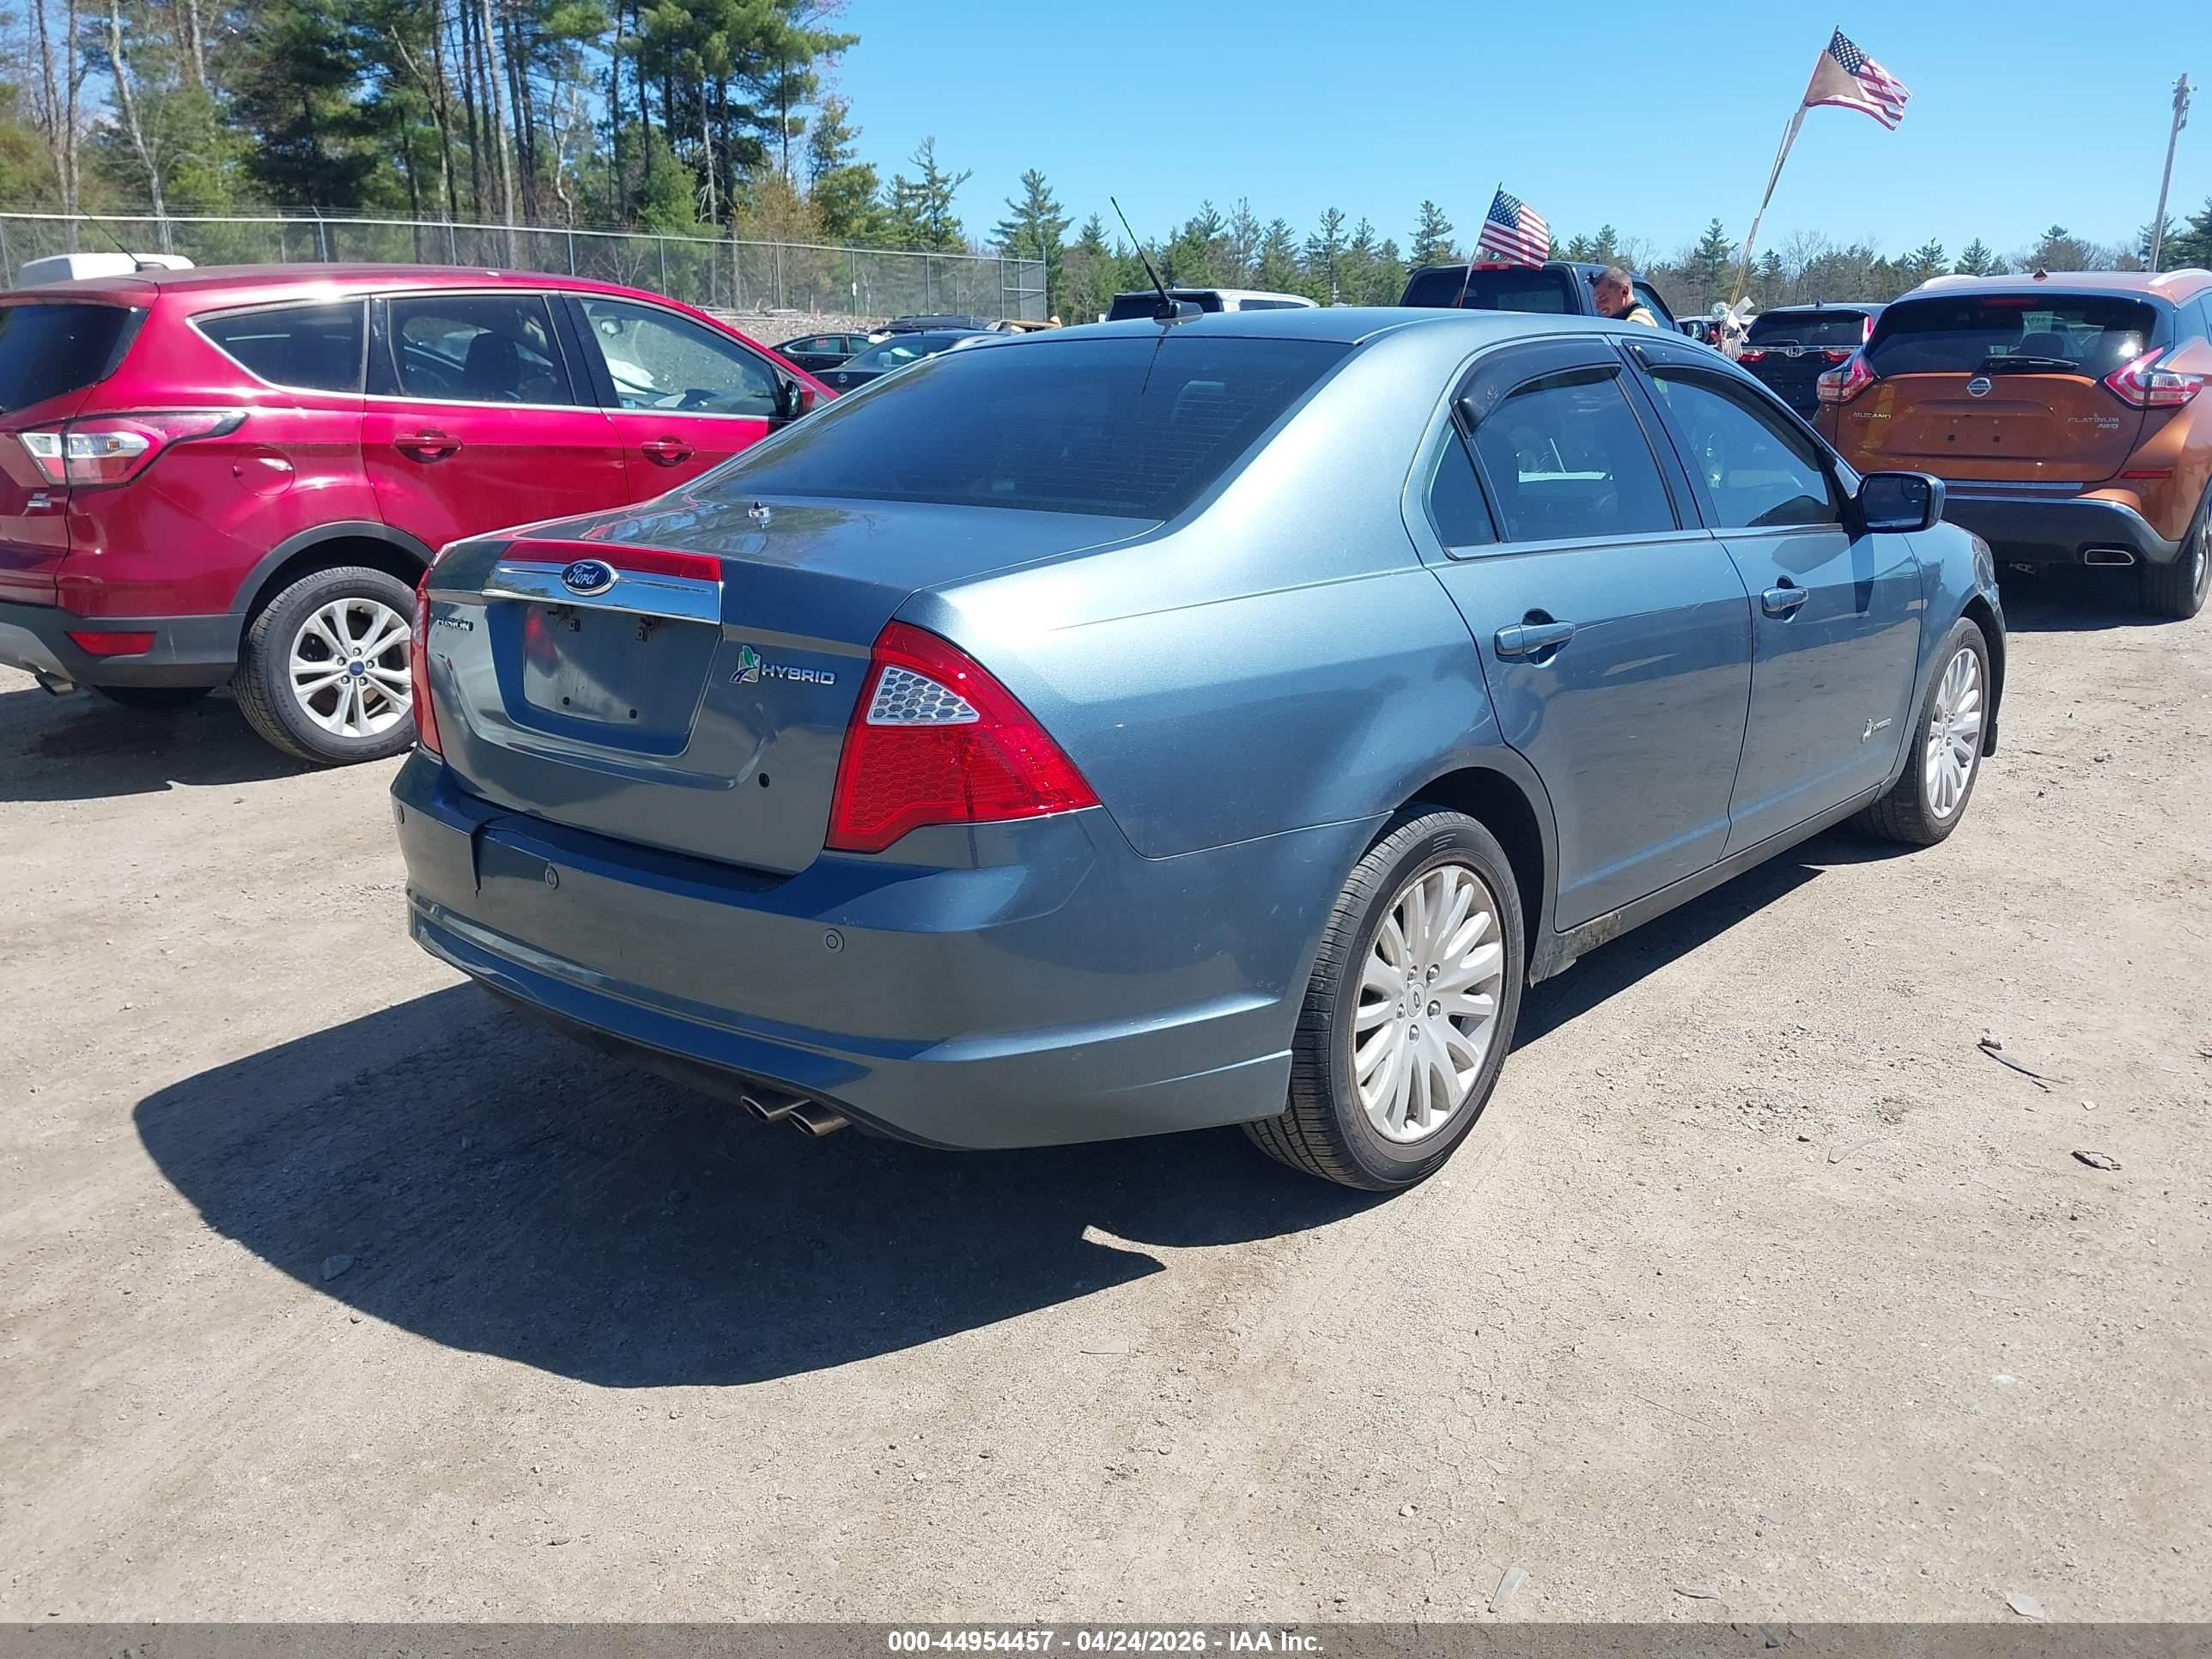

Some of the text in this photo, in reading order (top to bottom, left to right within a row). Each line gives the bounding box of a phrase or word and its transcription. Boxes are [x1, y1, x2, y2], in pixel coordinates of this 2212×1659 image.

[567, 563, 600, 586] Ford
[436, 618, 471, 631] FUSION
[761, 663, 836, 685] HYBRID
